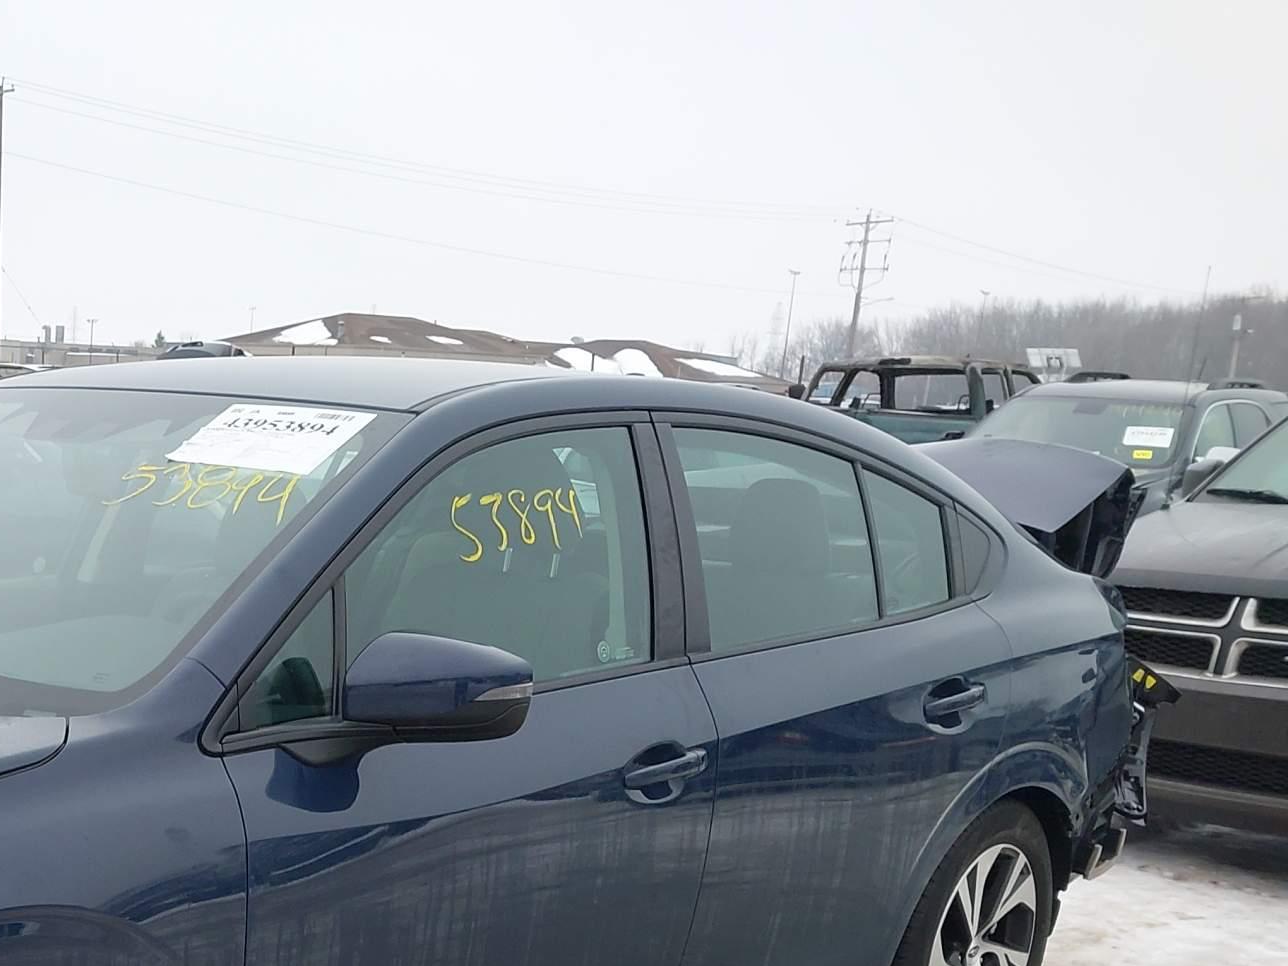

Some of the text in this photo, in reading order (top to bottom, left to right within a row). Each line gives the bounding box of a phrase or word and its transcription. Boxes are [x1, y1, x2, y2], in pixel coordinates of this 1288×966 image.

[223, 417, 340, 436] 43953894
[102, 463, 298, 527] 53894
[451, 487, 583, 563] 53894
